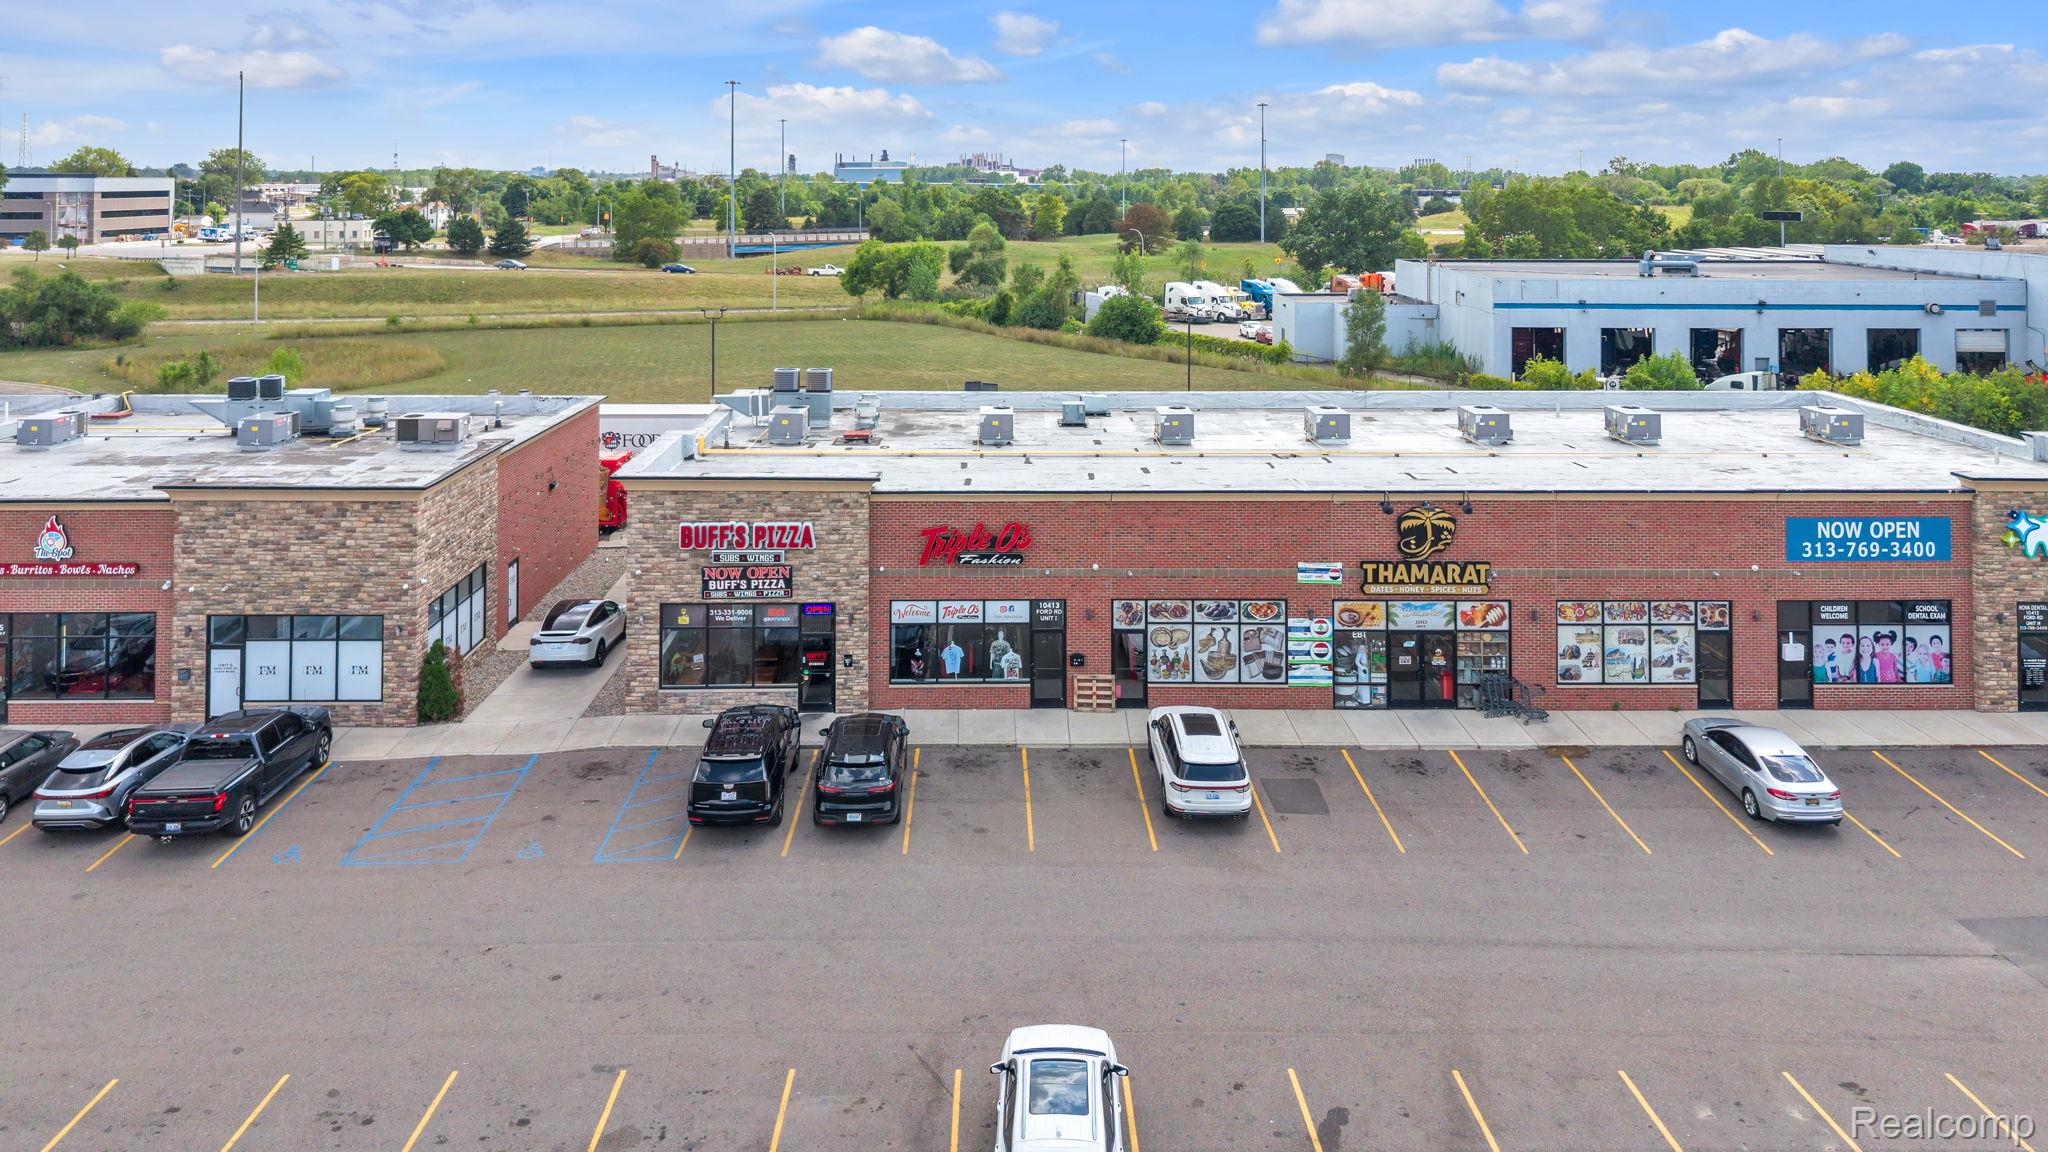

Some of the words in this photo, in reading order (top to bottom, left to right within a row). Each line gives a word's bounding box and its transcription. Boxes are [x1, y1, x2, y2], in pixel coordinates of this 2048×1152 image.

[680, 523, 748, 549] BUFF'S
[753, 523, 816, 549] PIZZA
[1817, 521, 1862, 539] NOW
[1870, 521, 1920, 539] OPEN
[919, 523, 992, 567] Triple
[1802, 541, 1936, 558] 313-769-3400
[51, 547, 72, 560] Spot
[719, 554, 740, 562] SUBS
[746, 554, 775, 562] WINGS
[959, 554, 1021, 565] Fashion
[10, 564, 53, 575] Burritos
[60, 564, 91, 575] Bowls
[97, 564, 135, 575] Nachos
[703, 567, 743, 580] NOW
[746, 566, 791, 579] OPEN
[1362, 563, 1490, 584] THAMARAT
[708, 579, 747, 590] BUFF'S
[751, 579, 786, 589] PIZZA
[893, 604, 931, 619] Welcome
[942, 604, 967, 620] Triple
[1820, 605, 1848, 613] CHILDREN
[1915, 605, 1939, 613] SCHOOL
[1820, 612, 1848, 620] WELCOME
[1908, 612, 1930, 620] DENTAL
[1930, 612, 1946, 620] EXAM
